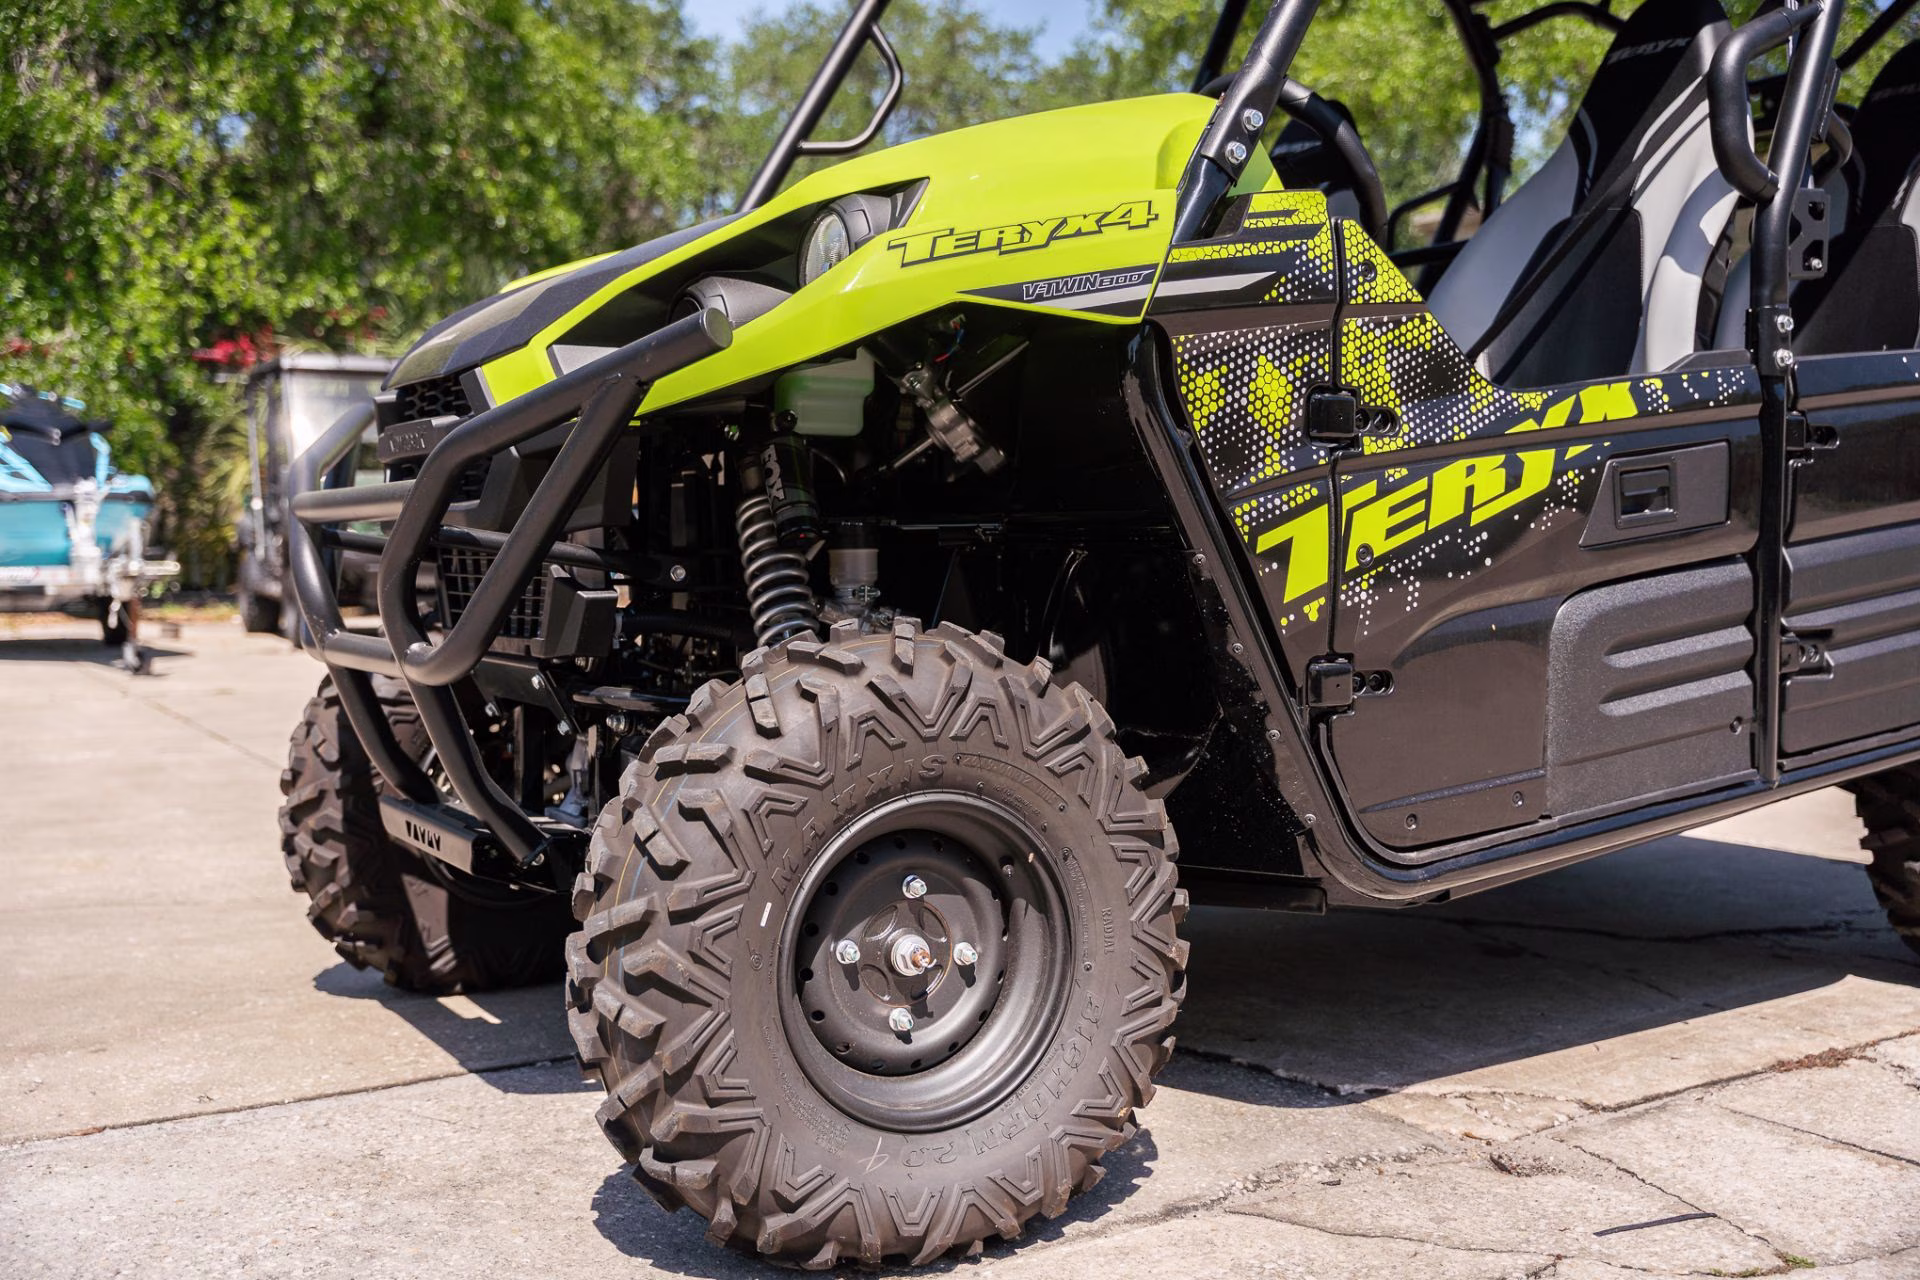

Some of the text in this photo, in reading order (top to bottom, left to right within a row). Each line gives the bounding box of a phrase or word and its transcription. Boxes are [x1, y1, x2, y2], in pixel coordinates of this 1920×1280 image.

[887, 199, 1159, 268] TERYX4
[760, 444, 785, 501] FOX
[1255, 381, 1640, 604] TERYX
[770, 753, 947, 895] MAXXIS
[1101, 905, 1115, 956] RADIAL
